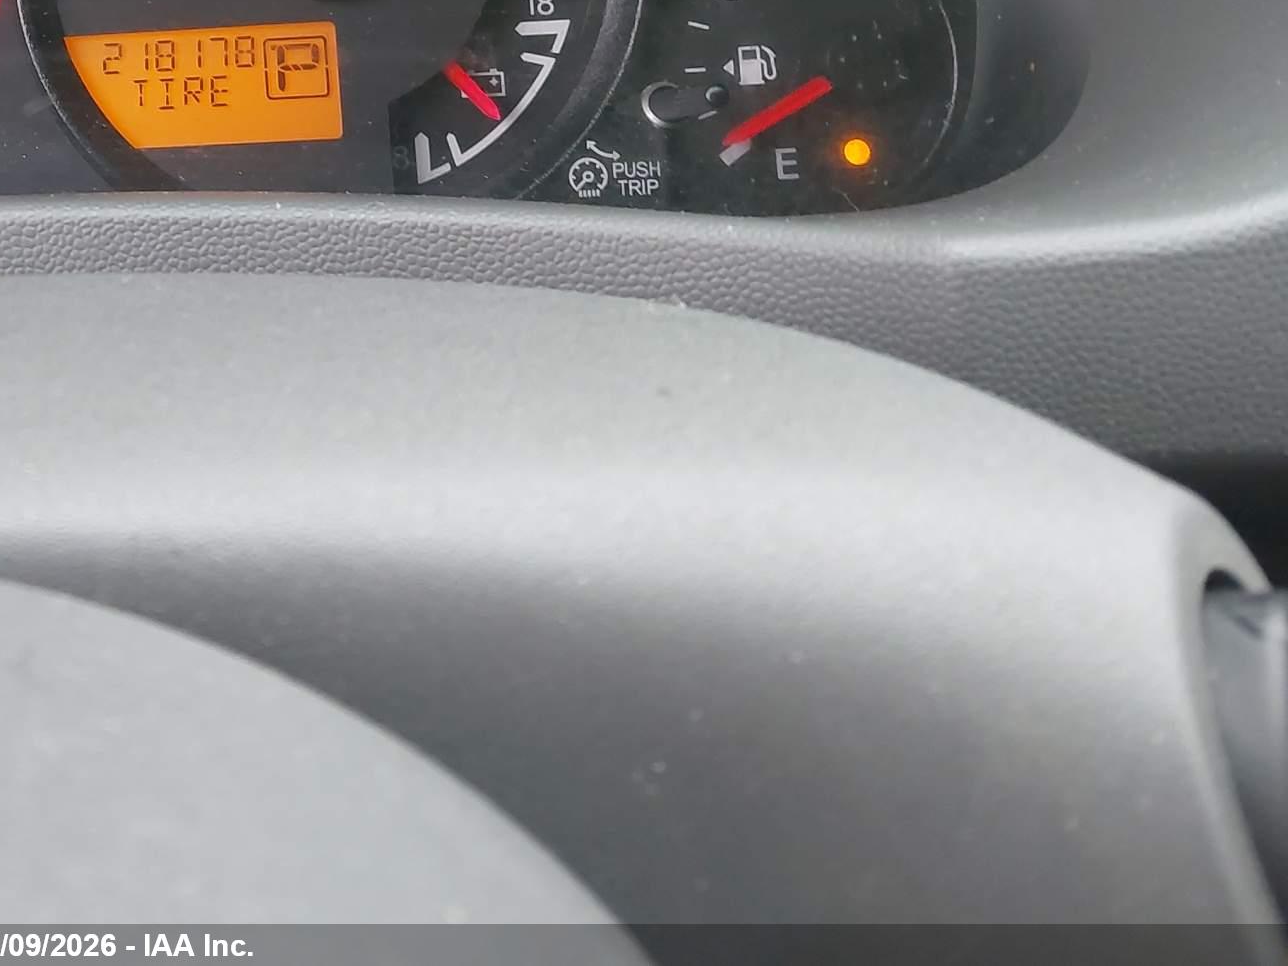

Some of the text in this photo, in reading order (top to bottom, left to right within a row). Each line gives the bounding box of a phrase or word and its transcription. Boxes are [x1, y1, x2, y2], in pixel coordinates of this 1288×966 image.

[103, 35, 320, 92] 218178 P
[133, 75, 229, 110] TIRE
[612, 160, 661, 179] PUSH
[775, 147, 800, 180] E
[617, 178, 659, 196] TRIP
